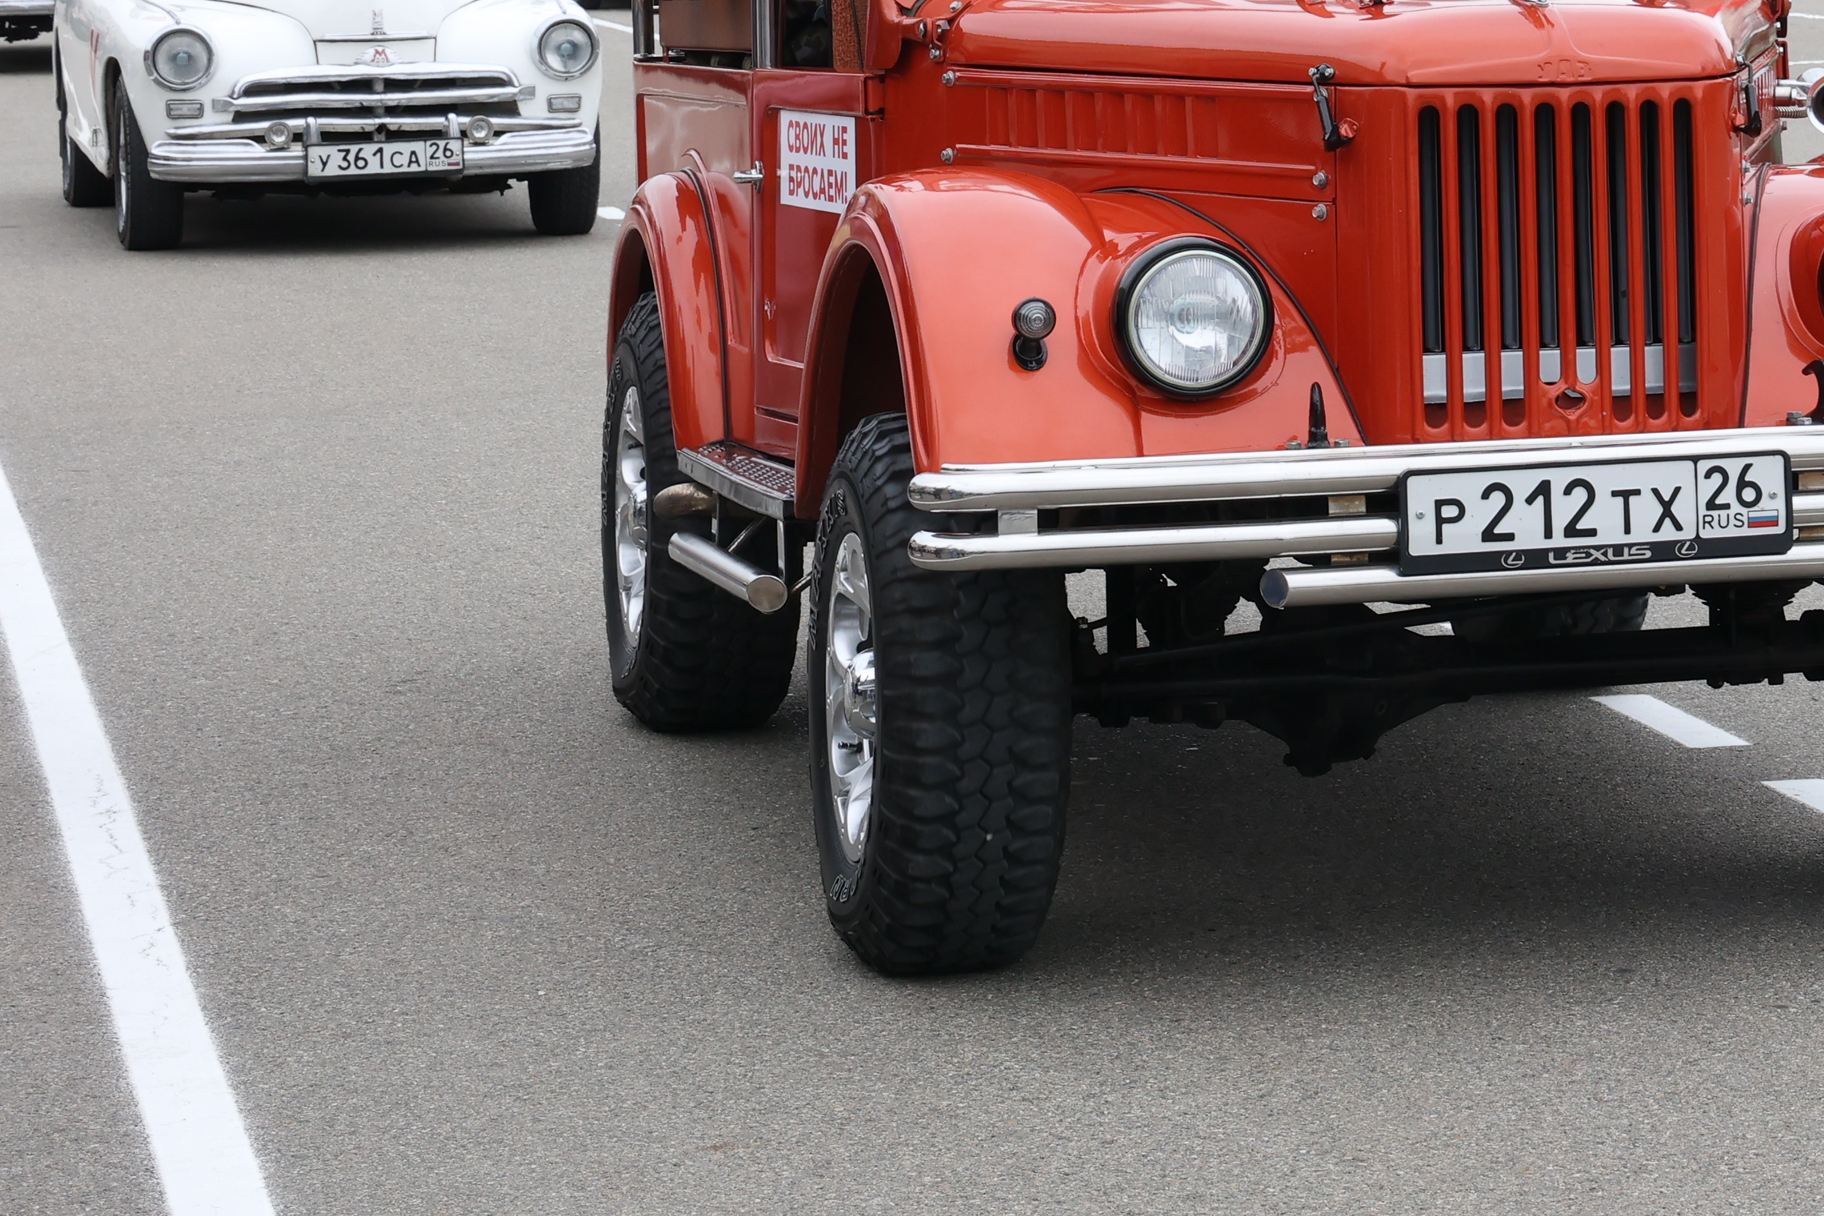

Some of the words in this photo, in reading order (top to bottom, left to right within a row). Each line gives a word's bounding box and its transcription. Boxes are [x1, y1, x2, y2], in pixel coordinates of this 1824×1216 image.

[787, 119, 827, 157] СВОИХ
[832, 124, 849, 160] НЕ
[428, 142, 455, 160] 26
[428, 160, 447, 168] RUS
[788, 163, 849, 205] БРОСАЕМ!
[1704, 463, 1763, 511] 26
[1702, 512, 1745, 530] RUS
[1547, 545, 1653, 565] LEXUS
